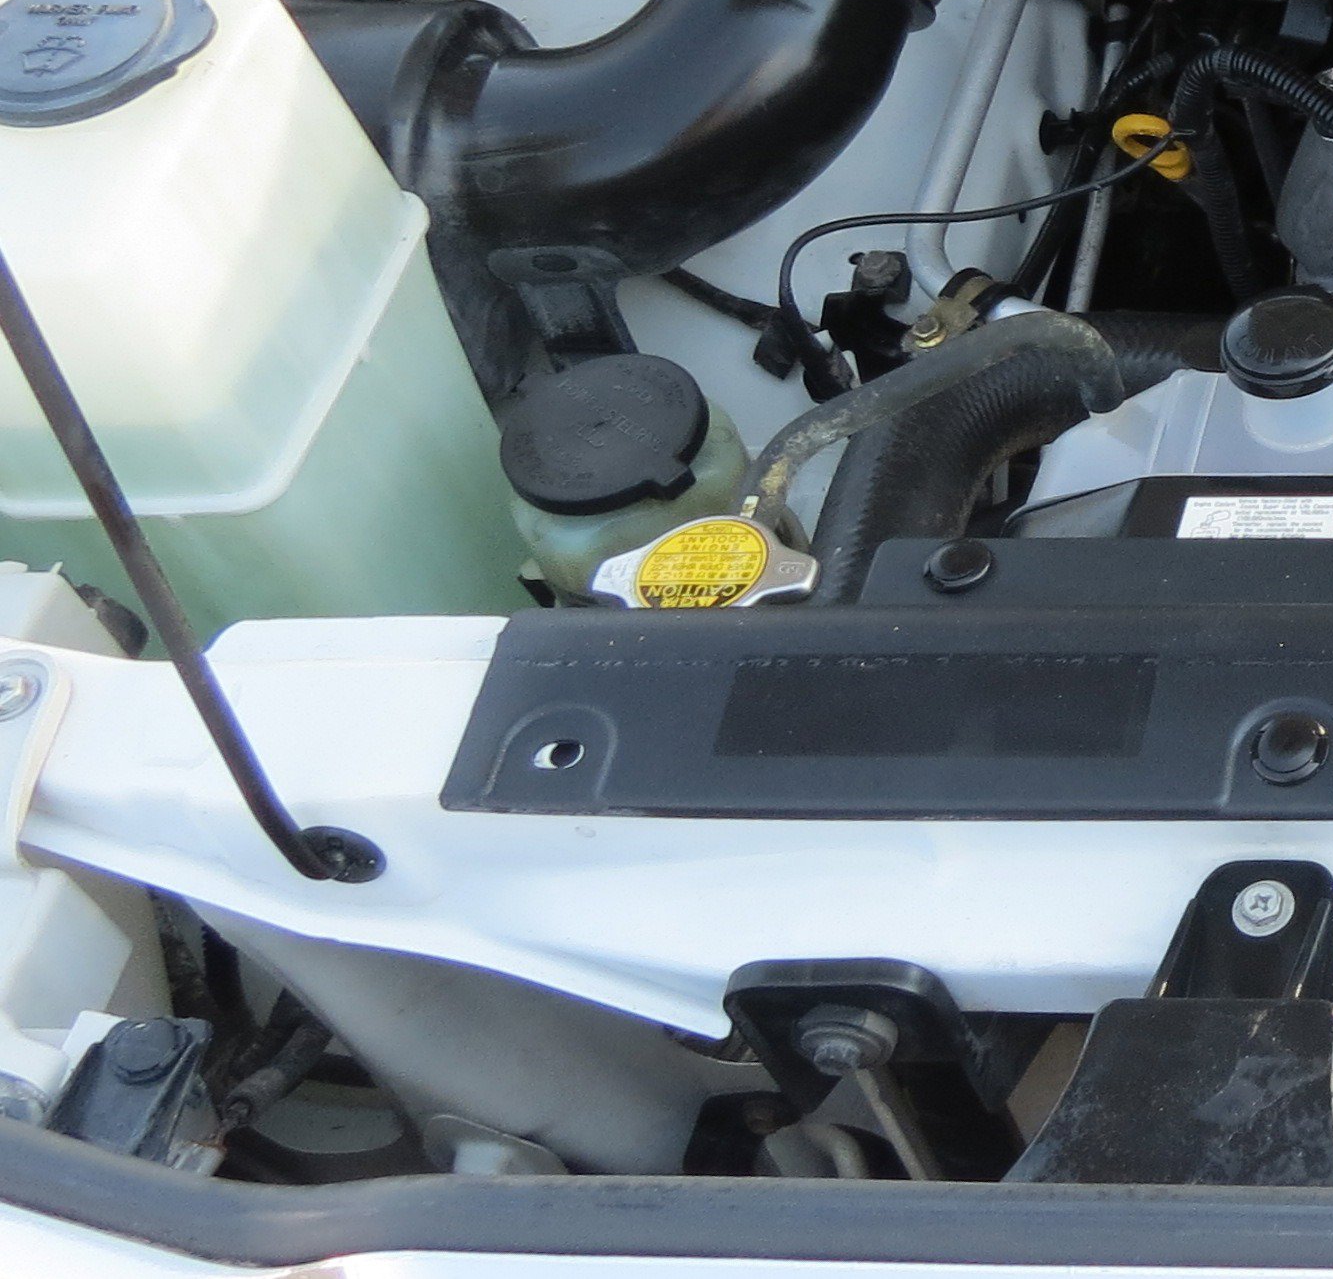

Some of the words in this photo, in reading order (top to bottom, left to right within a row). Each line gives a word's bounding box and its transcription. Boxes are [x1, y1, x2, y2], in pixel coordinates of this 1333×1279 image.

[677, 534, 749, 544] COOLANT
[680, 542, 740, 552] ENGINE
[646, 583, 738, 598] CAUTION
